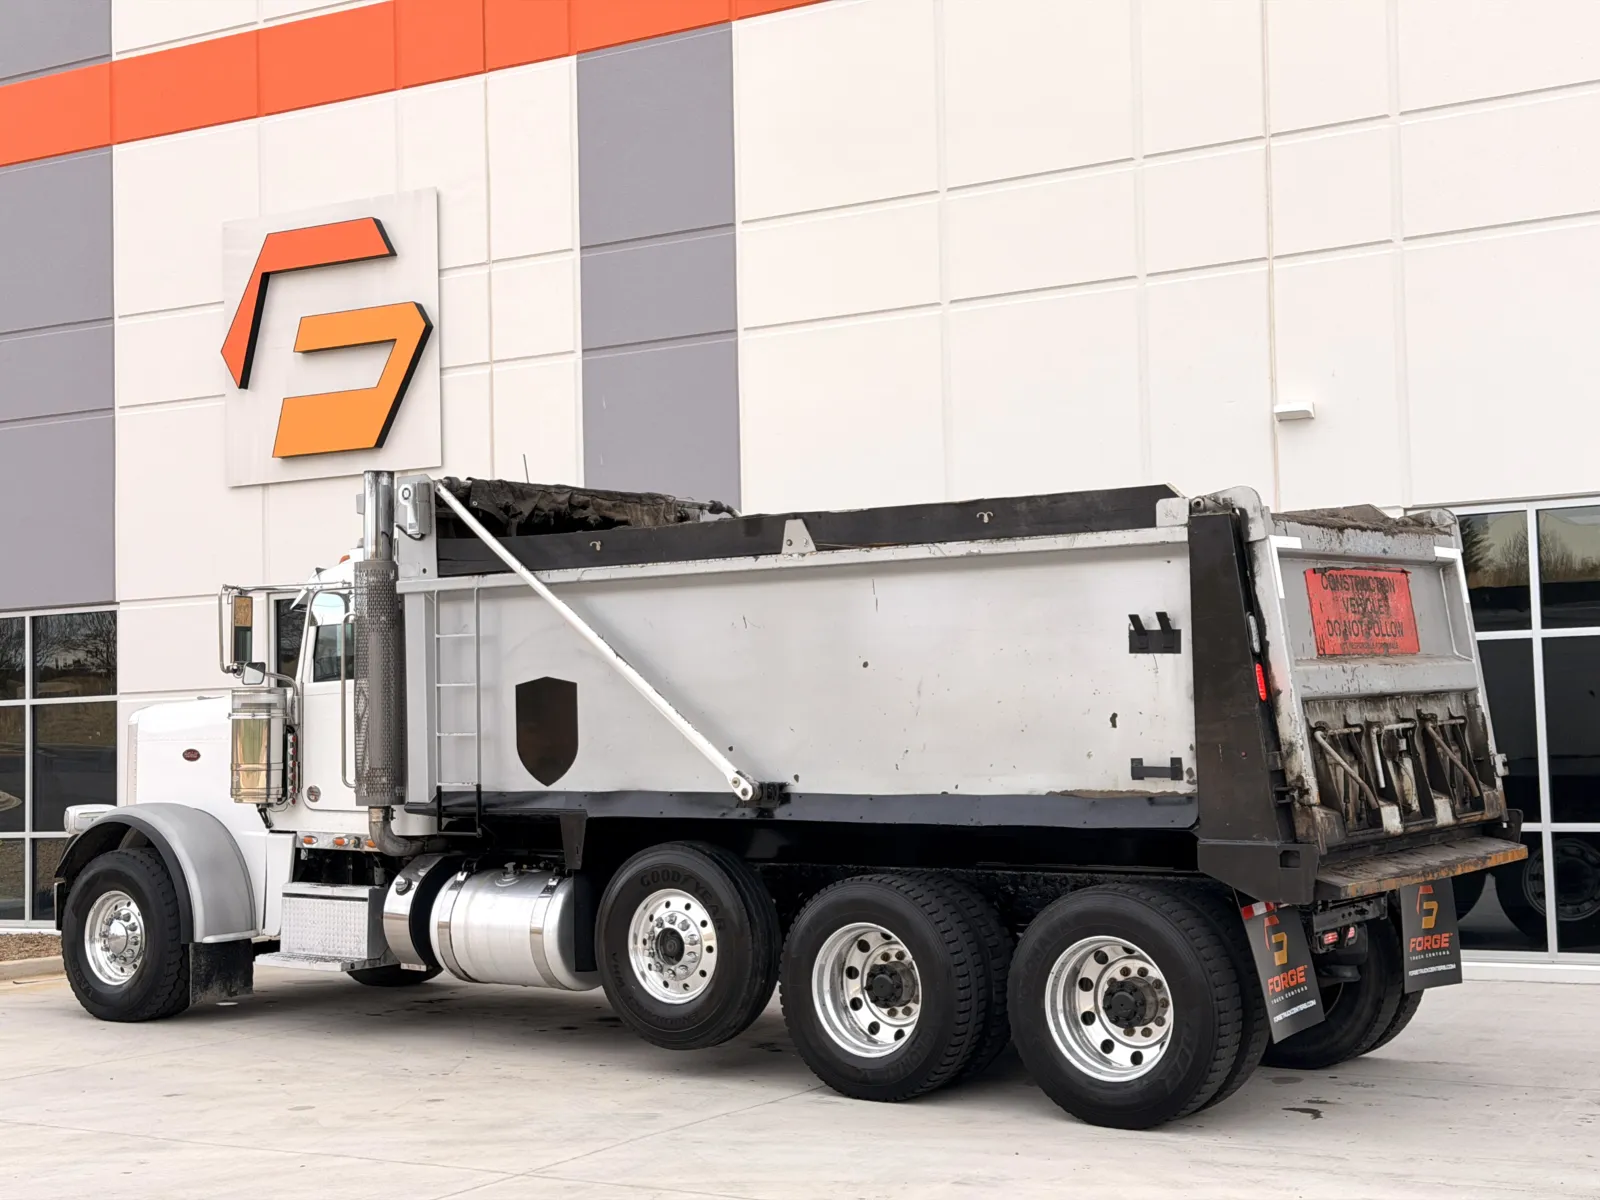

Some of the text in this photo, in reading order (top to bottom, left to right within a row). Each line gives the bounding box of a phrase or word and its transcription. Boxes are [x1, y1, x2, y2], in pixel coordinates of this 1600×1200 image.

[1321, 573, 1396, 593] CONSTRUCTION
[1326, 620, 1341, 637] DO
[1343, 620, 1363, 638] NOT
[640, 869, 727, 931] GOODYEAR
[1409, 932, 1450, 953] FORGE
[1267, 965, 1307, 996] FORGE
